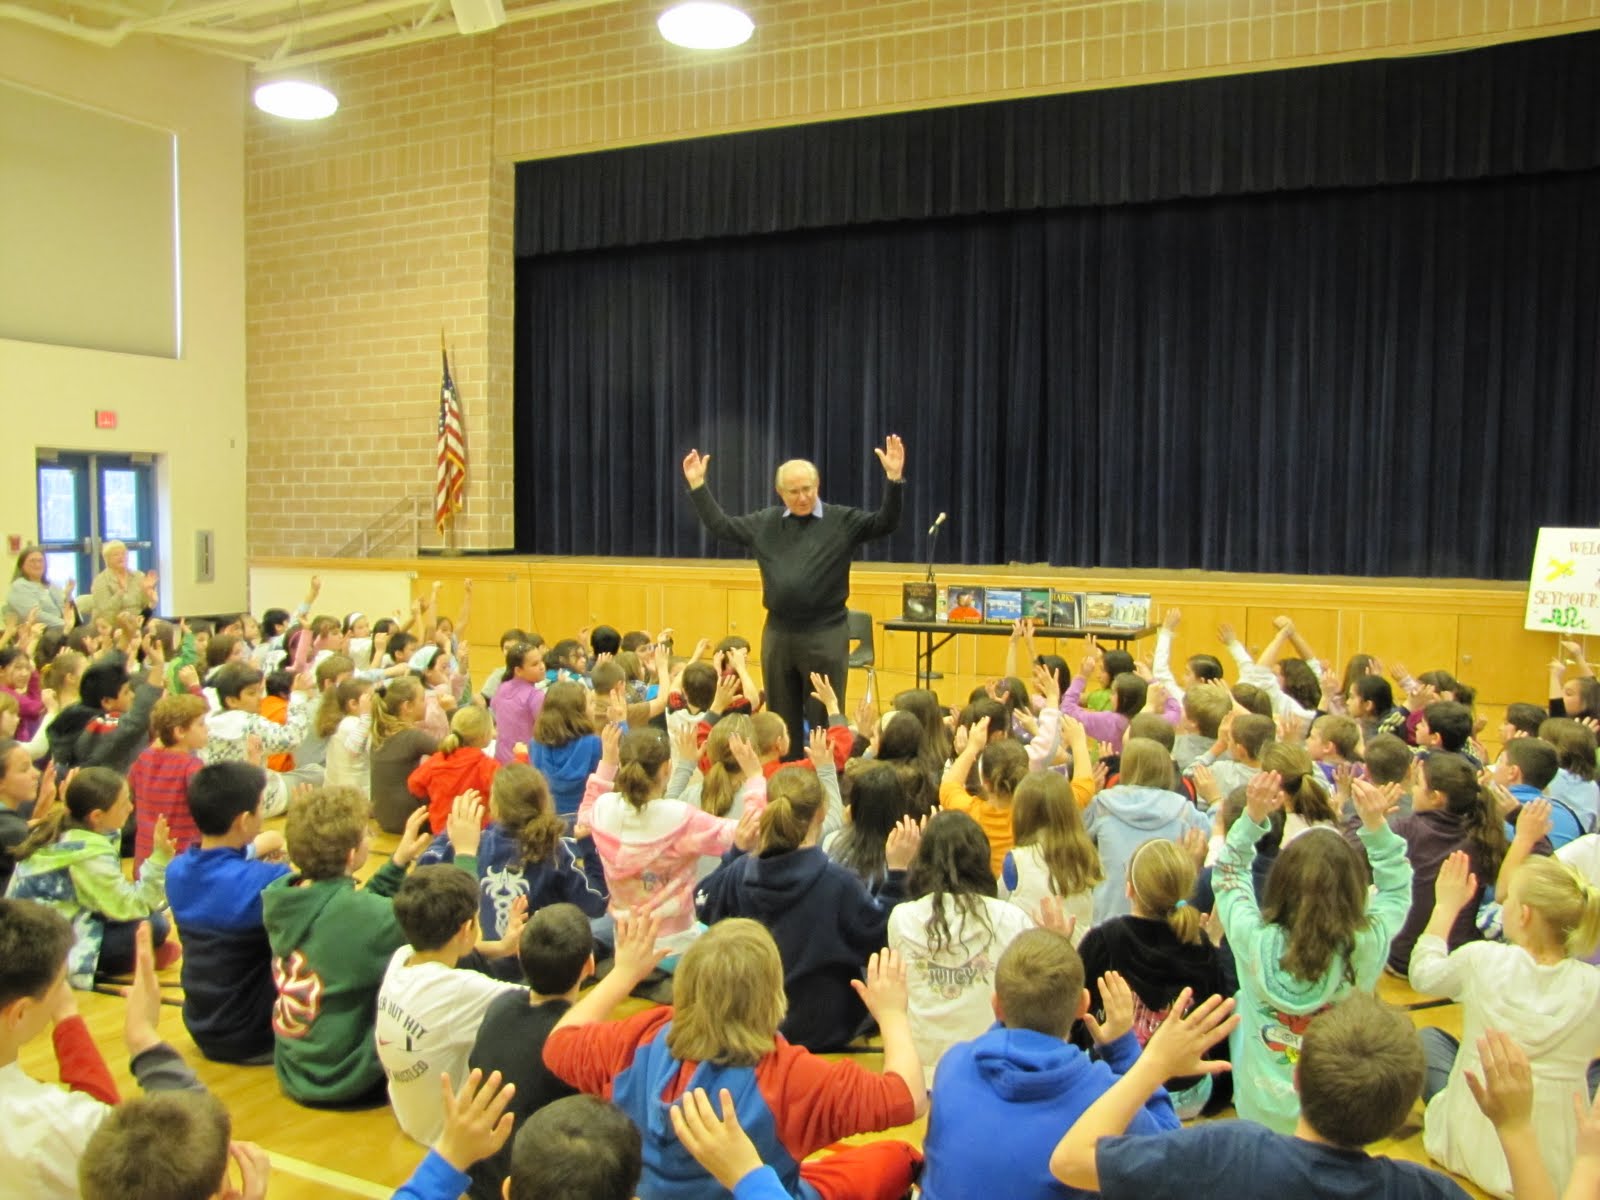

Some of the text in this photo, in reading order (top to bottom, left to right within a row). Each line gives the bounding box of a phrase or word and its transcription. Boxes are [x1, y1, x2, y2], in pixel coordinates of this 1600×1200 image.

[1534, 590, 1598, 608] SEYMOUR
[928, 967, 978, 985] JUICY
[403, 1014, 429, 1040] HIT
